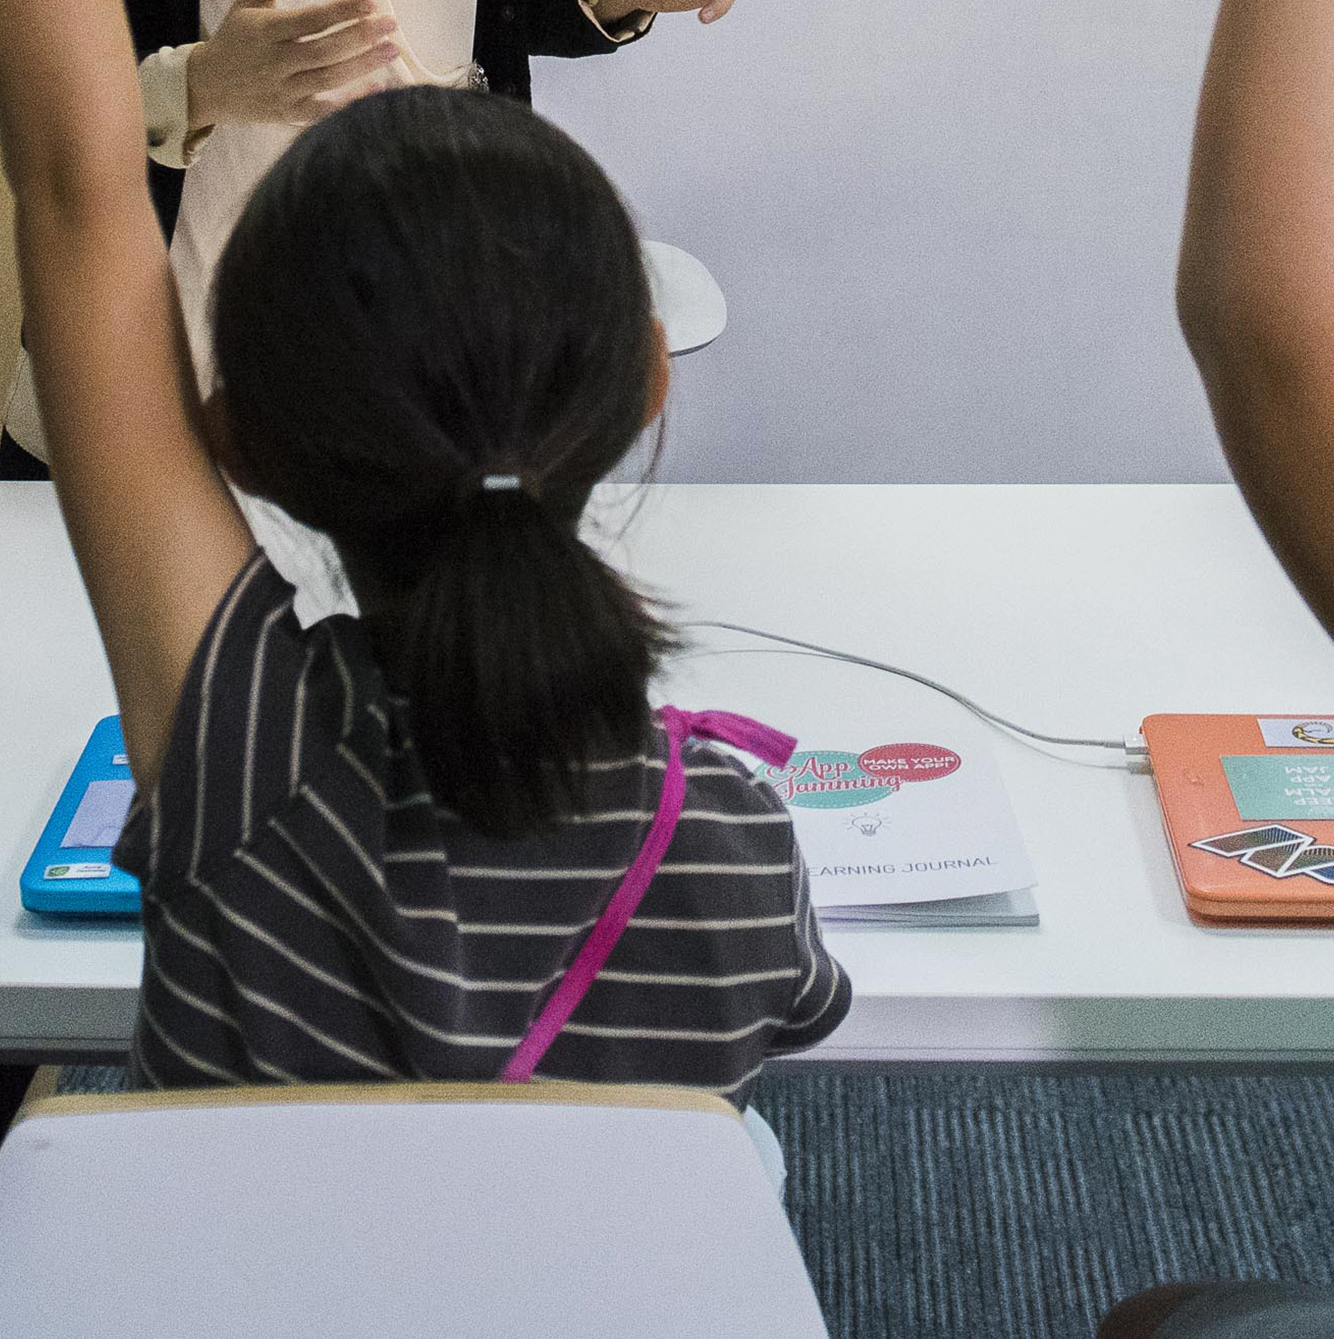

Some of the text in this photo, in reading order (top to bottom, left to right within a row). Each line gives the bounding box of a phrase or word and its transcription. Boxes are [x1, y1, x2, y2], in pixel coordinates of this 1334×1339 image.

[863, 756, 956, 766] MAKE YOUR
[767, 756, 855, 781] App
[868, 763, 909, 771] OWN
[1284, 765, 1329, 774] JAM
[1290, 774, 1331, 783] APP
[771, 775, 903, 801] Jamming
[807, 856, 999, 877] EARNING JOURNAL
